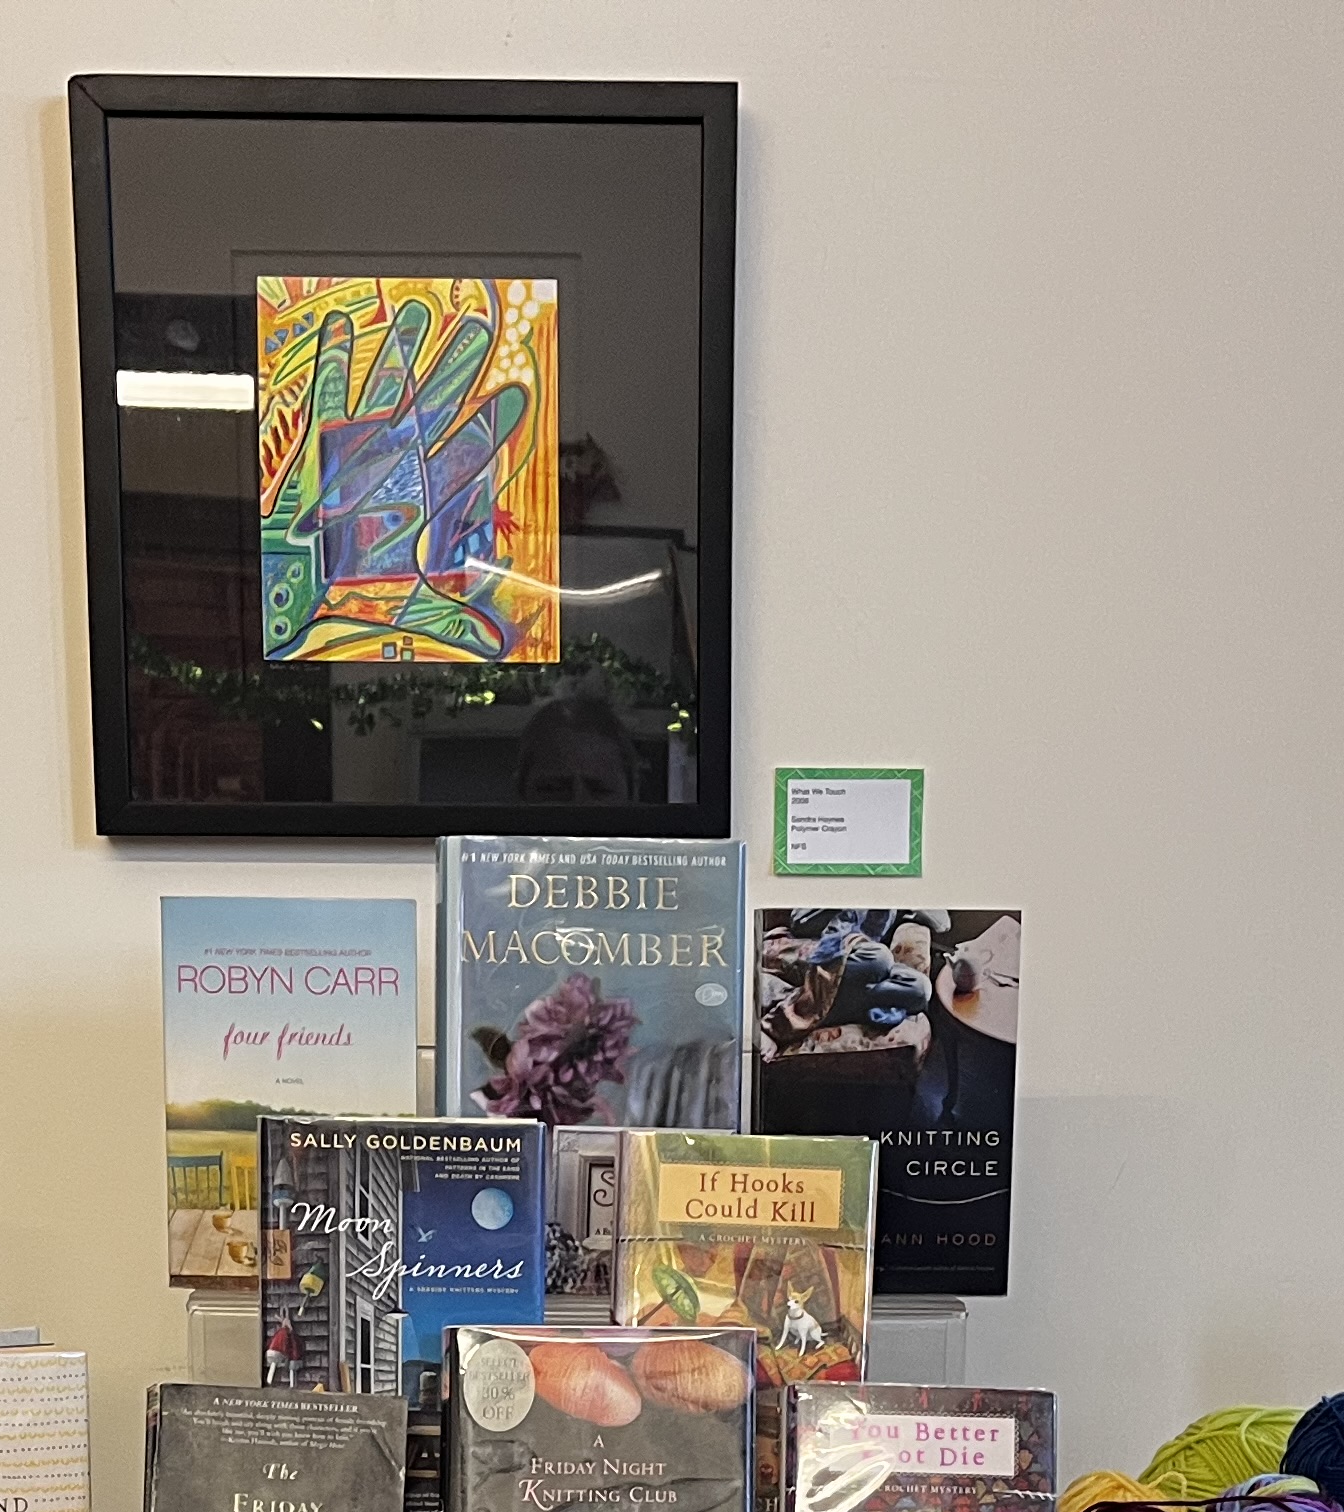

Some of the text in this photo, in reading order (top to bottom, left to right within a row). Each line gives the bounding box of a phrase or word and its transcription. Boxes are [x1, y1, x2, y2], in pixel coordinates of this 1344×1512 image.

[480, 853, 499, 863] NEW
[501, 853, 525, 863] YORK
[558, 854, 576, 864] AND
[580, 854, 596, 864] USA
[602, 854, 630, 865] TODAY
[632, 855, 688, 866] BESTSELLING
[691, 856, 726, 866] AUTHOR
[507, 874, 679, 911] DEBBIE
[461, 929, 729, 967] MACOMBER
[177, 965, 400, 996] ROBYN CARR
[223, 1022, 355, 1061] four friends
[290, 1133, 521, 1152] SALLY GOLDENBAUM
[880, 1130, 1001, 1147] KNITTING
[905, 1160, 999, 1177] CIRCLE
[699, 1172, 804, 1194] If Hooks
[290, 1202, 394, 1234] Moon
[685, 1199, 815, 1223] Could Kill
[881, 1233, 997, 1246] ANN HOOD
[346, 1241, 524, 1300] Spinners
[213, 1397, 220, 1405] A
[244, 1400, 270, 1408] YORK
[271, 1401, 299, 1409] TIMES
[300, 1402, 358, 1412] BESTSELLER
[483, 1406, 514, 1419] OFF
[593, 1435, 604, 1448] A
[916, 1422, 999, 1442] Better
[939, 1447, 985, 1466] Die
[263, 1462, 299, 1481] The
[531, 1458, 667, 1476] FRIDAY NIGHT
[519, 1479, 678, 1512] KNITTING CLUB
